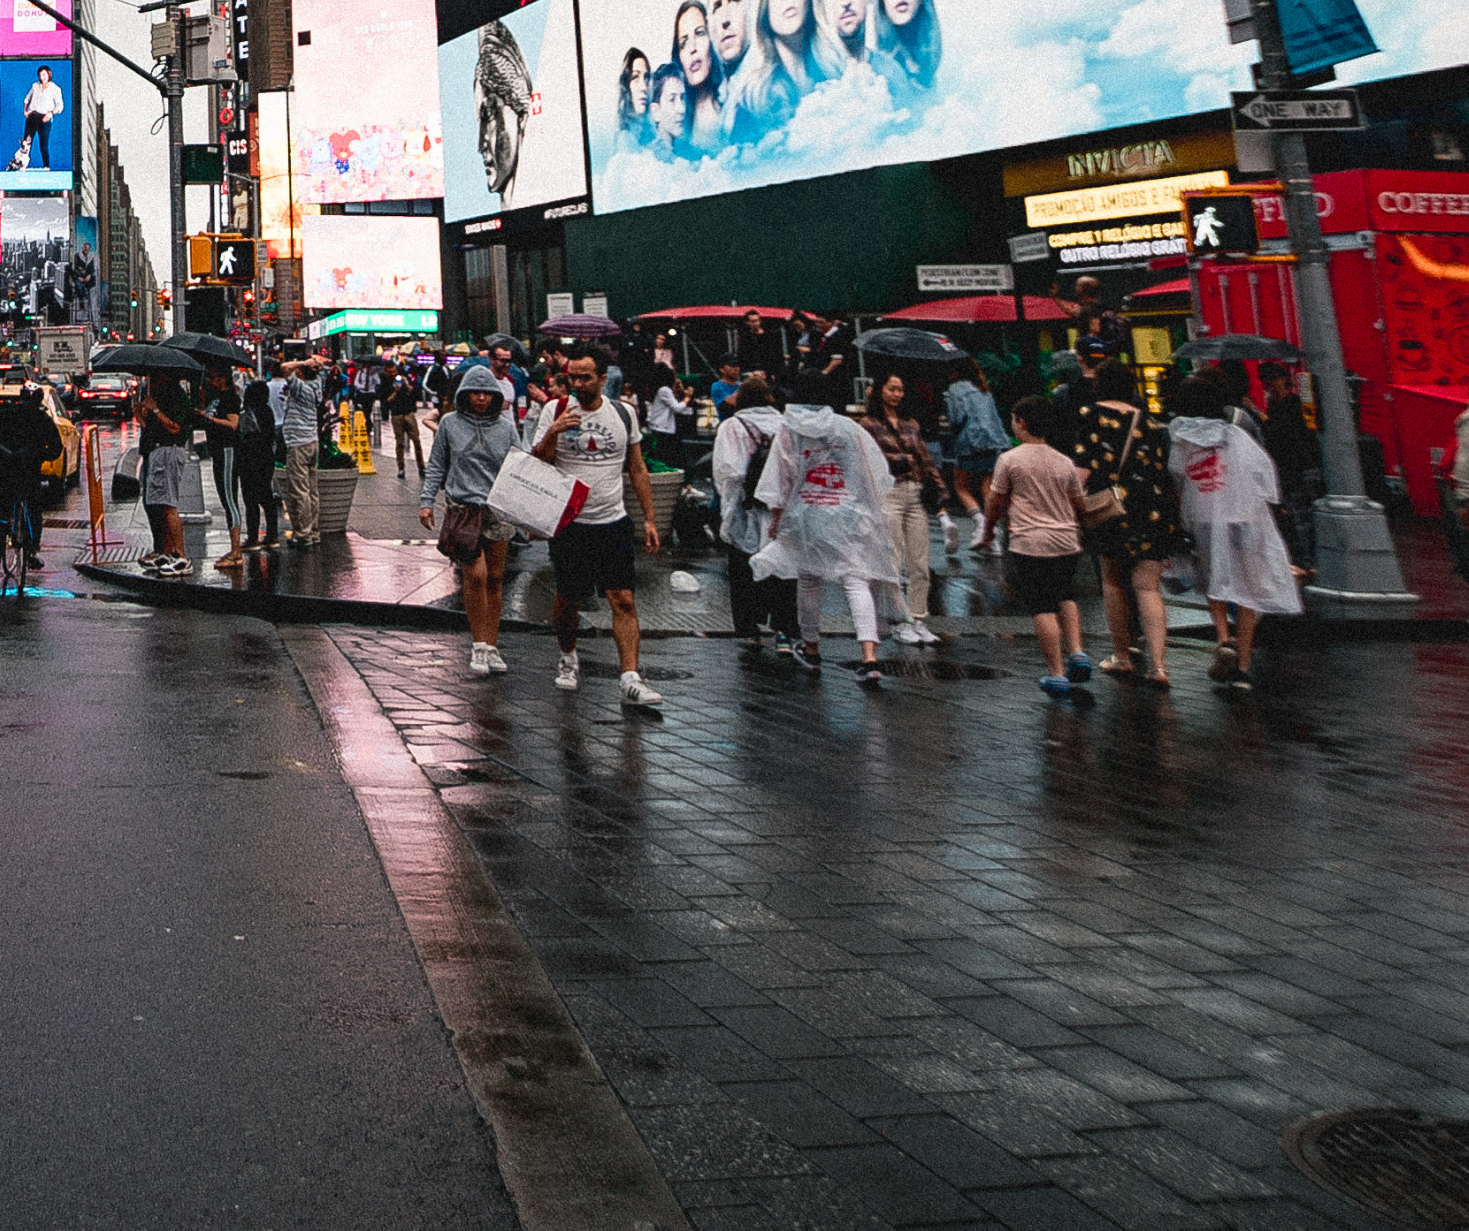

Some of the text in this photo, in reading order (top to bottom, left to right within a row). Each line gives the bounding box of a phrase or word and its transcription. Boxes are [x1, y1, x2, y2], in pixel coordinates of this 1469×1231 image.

[1251, 101, 1343, 117] ONE WAY
[1067, 139, 1175, 180] INVICTA
[1100, 192, 1146, 214] AMIGOS
[1059, 245, 1098, 263] OUTRO
[1152, 236, 1186, 256] GRÁT
